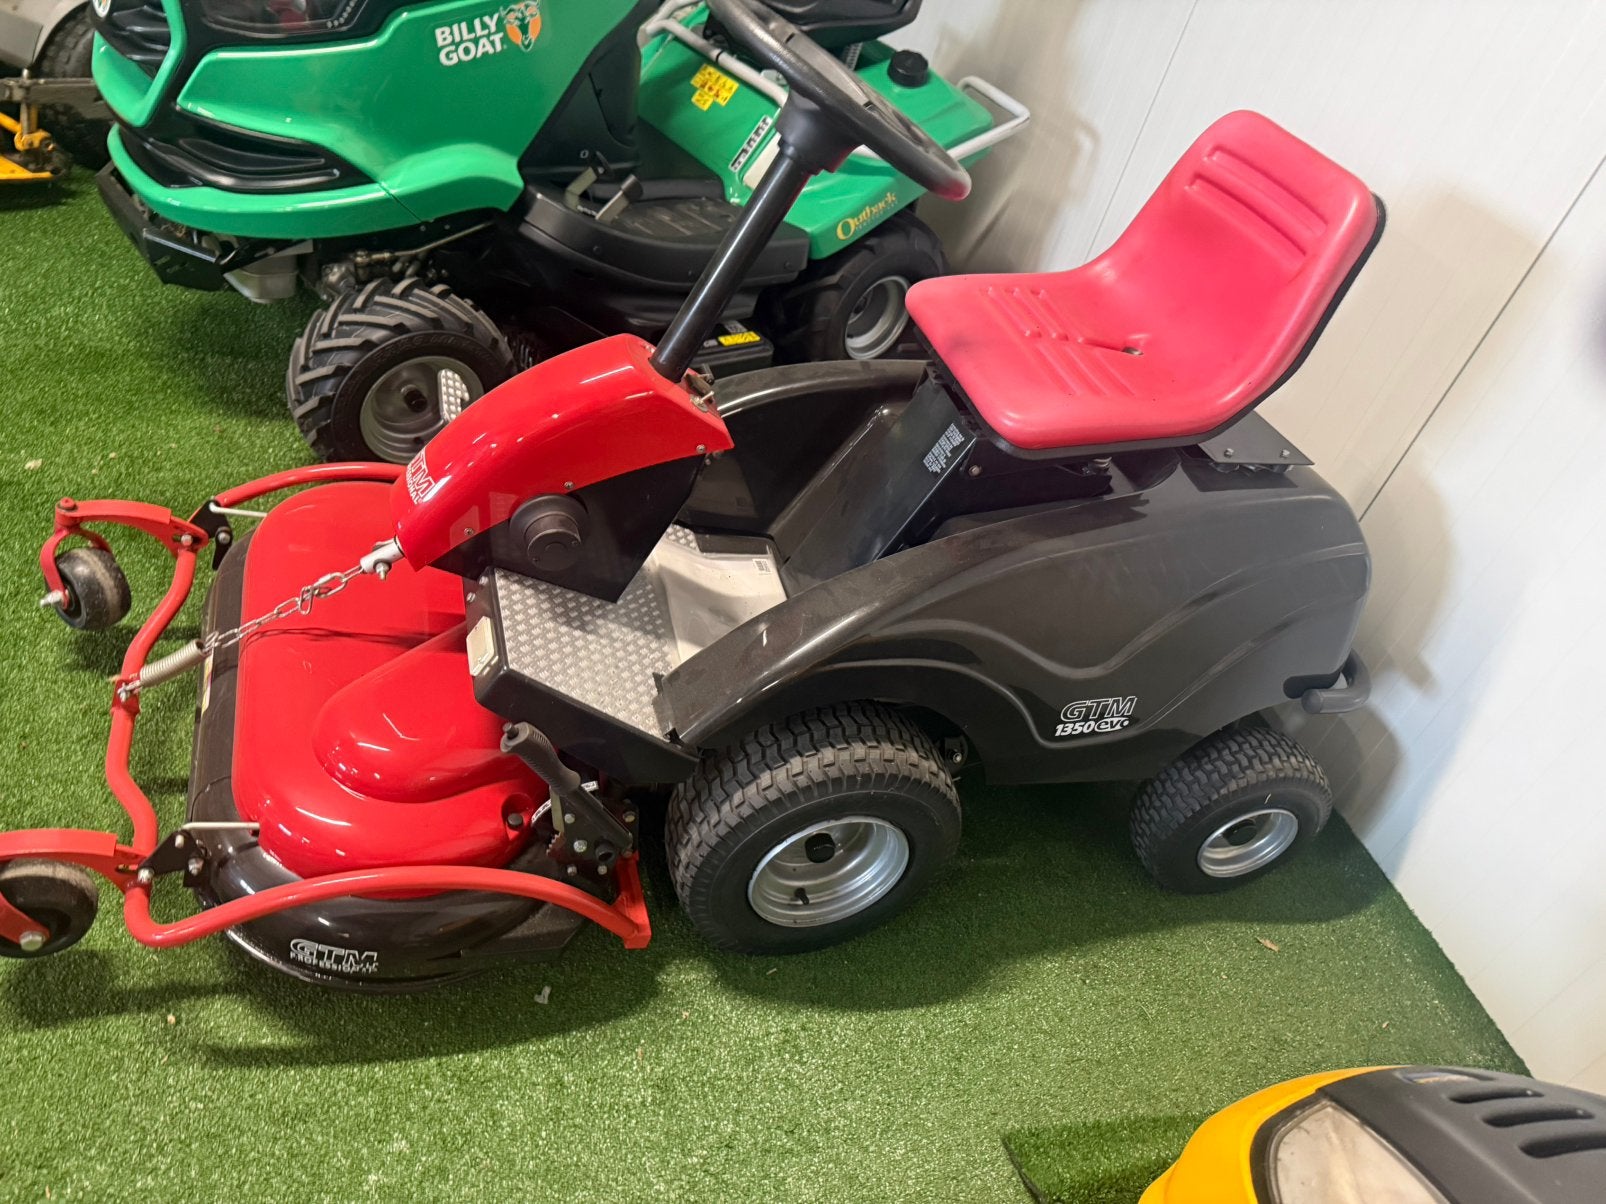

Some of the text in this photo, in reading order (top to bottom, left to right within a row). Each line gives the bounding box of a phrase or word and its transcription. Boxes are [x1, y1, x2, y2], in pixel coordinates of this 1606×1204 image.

[434, 13, 499, 48] BILLY
[439, 32, 504, 66] GOAT
[1060, 695, 1138, 722] GTM
[290, 938, 378, 966] GTM
